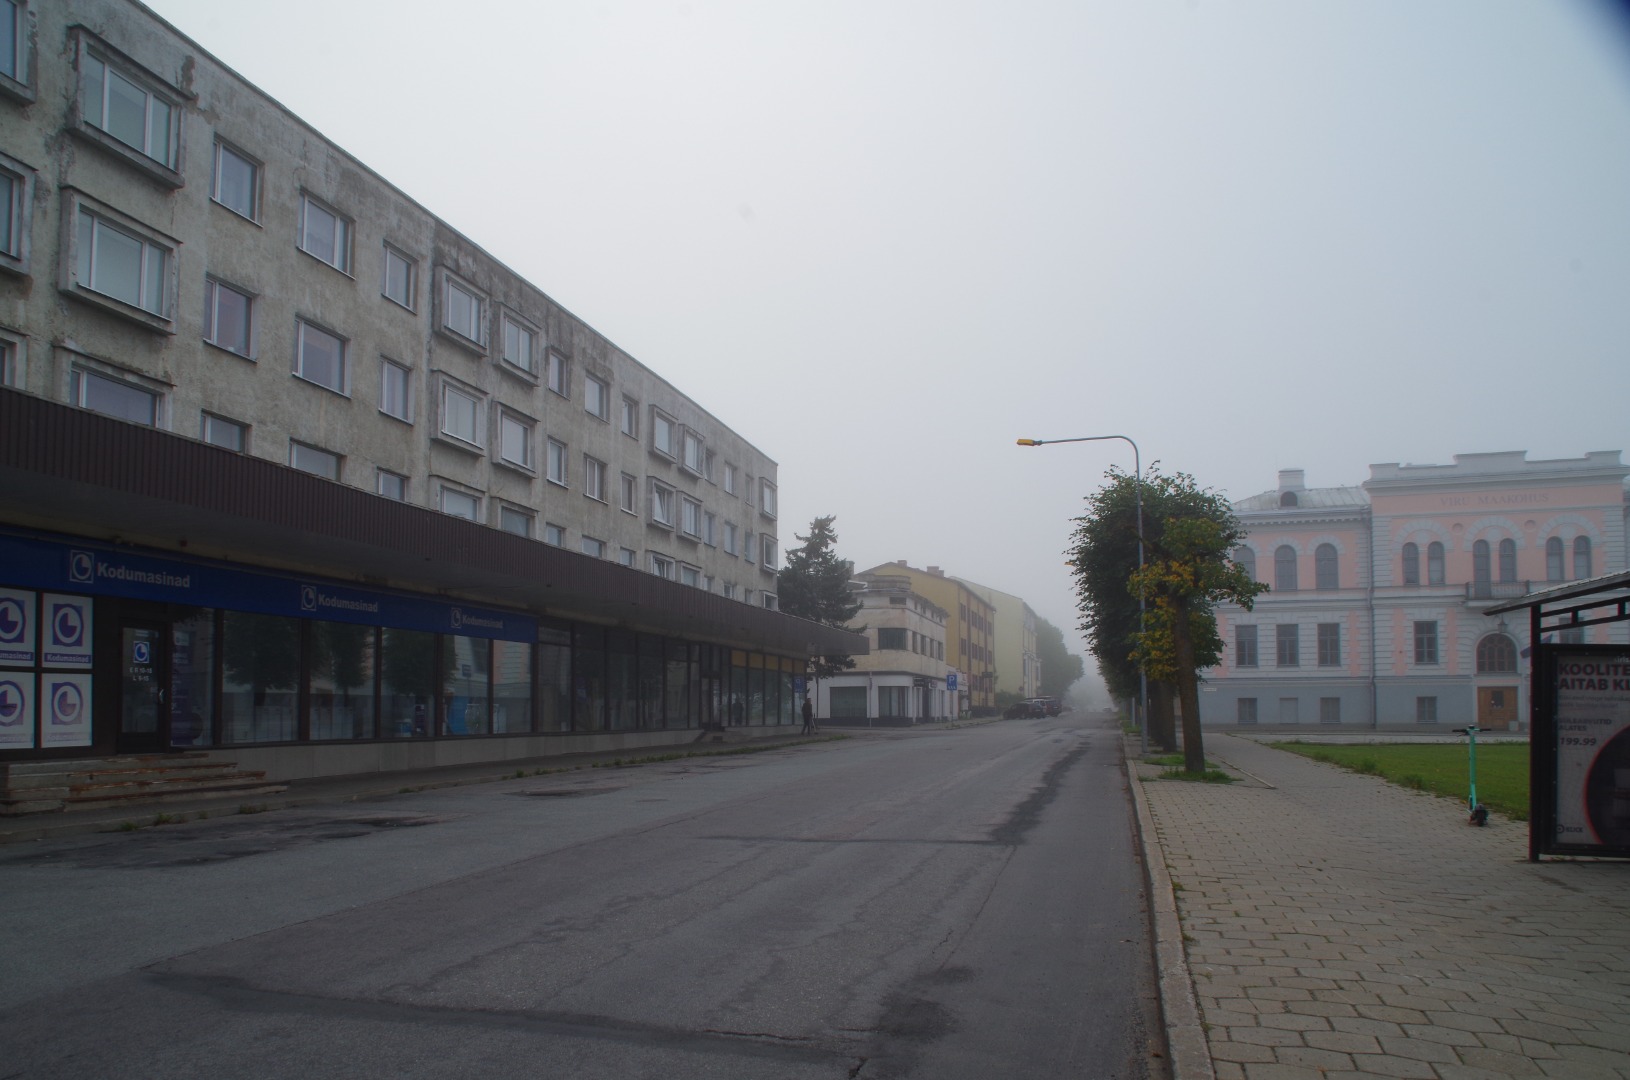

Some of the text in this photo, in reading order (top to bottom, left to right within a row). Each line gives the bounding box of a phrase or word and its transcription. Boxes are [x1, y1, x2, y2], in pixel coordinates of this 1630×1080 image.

[1440, 493, 1549, 506] VIRU MAAKOHUS
[97, 561, 190, 587] Kodumasinad
[318, 593, 378, 612] Kodumasinad
[462, 614, 504, 629] Kodumasinad
[47, 653, 90, 663] Kodumasinad
[1559, 678, 1609, 690] AITAB
[1560, 737, 1597, 746] 199.99
